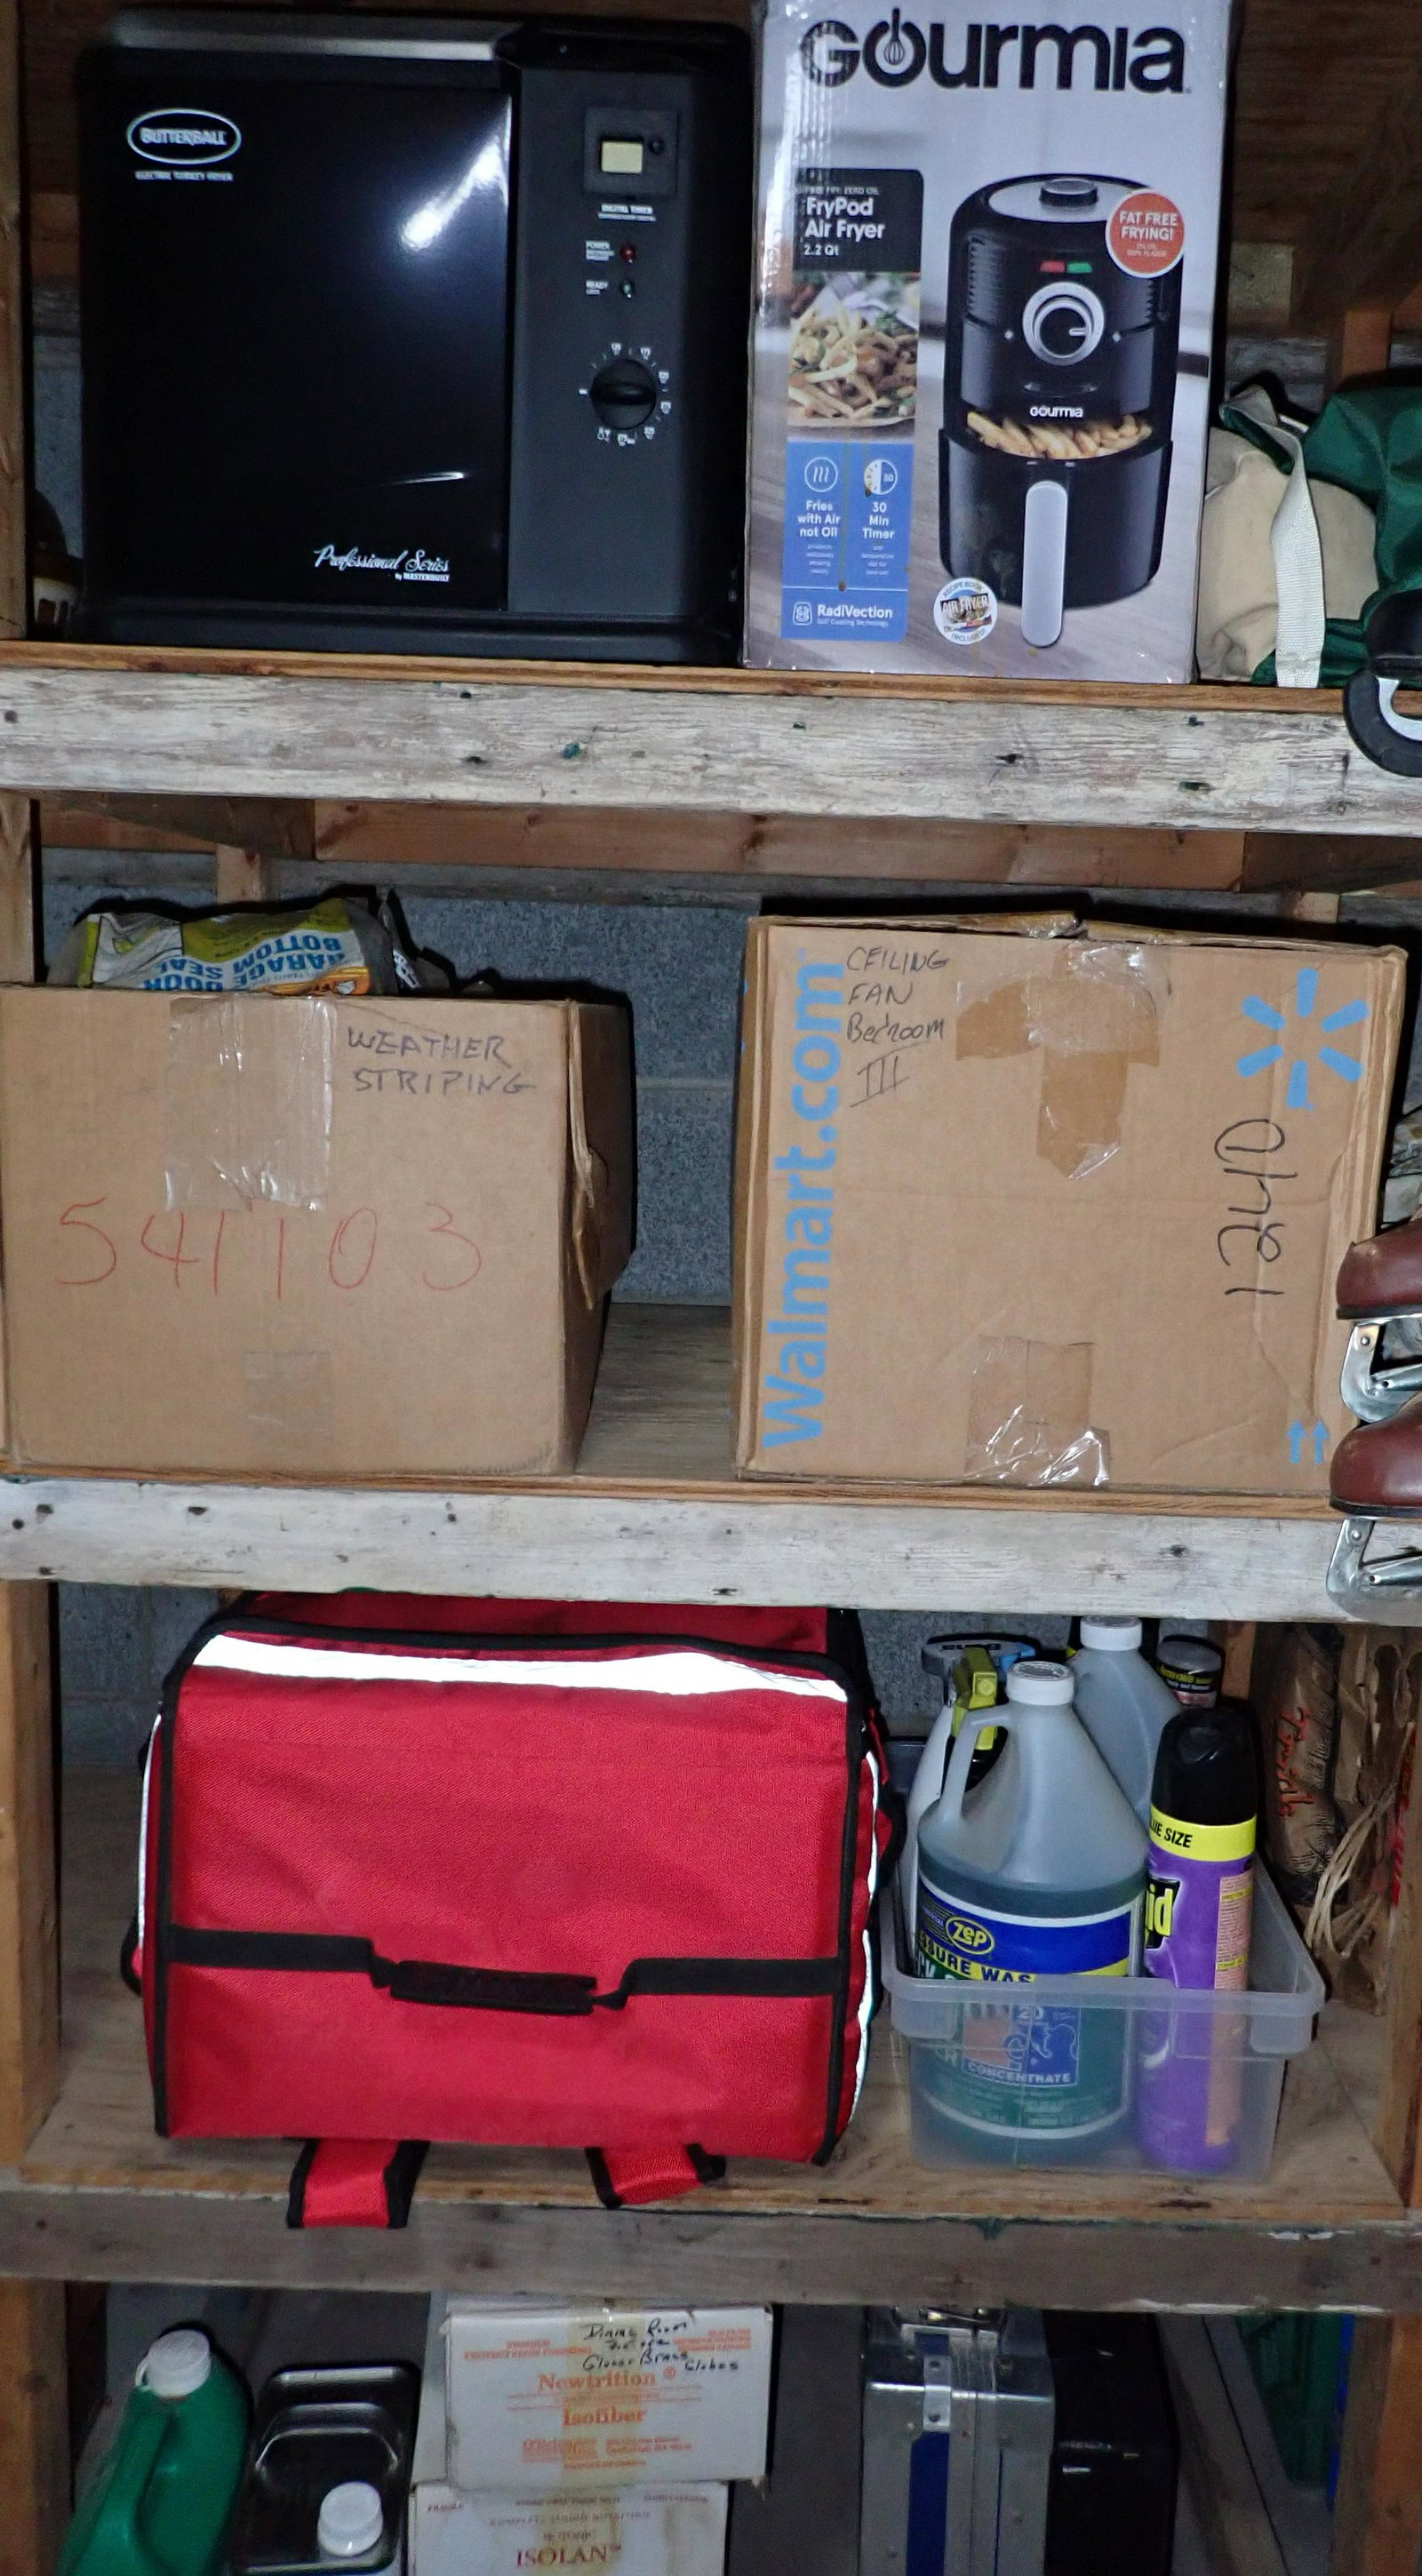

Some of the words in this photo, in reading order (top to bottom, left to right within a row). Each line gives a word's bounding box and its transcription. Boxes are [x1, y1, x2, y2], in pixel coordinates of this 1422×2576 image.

[800, 8, 1186, 93] Gourmia
[806, 196, 874, 219] FryPod
[1120, 211, 1142, 224] FAT
[1145, 211, 1178, 227] FREE
[804, 219, 832, 238] Air
[836, 219, 885, 243] Fryer
[1121, 226, 1174, 241] FRYING!
[803, 243, 822, 256] 2.2
[825, 243, 840, 256] Qt
[1029, 404, 1084, 419] Gourmia
[806, 500, 834, 512] Fries
[872, 501, 887, 513] 30
[797, 514, 822, 525] with
[824, 514, 841, 525] Air
[868, 514, 889, 526] Min
[800, 527, 819, 538] not
[821, 527, 838, 538] Oil
[862, 528, 895, 539] Timer
[314, 544, 409, 571] Professional
[405, 549, 450, 572] Series
[818, 604, 893, 618] RadiVection
[233, 934, 341, 975] BOTTOM
[848, 981, 913, 1006] FAN
[847, 1011, 945, 1044] Bedroom
[348, 1026, 512, 1069] WEATHER
[353, 1068, 537, 1096] STRIPING
[762, 962, 845, 1449] Walmart.com
[1163, 1828, 1193, 1848] SIZE
[967, 2062, 1071, 2084] CONCENTRATE
[538, 2370, 656, 2391] Newtrition
[562, 2406, 647, 2427] Isofiber
[516, 2546, 608, 2568] ISOLAN
